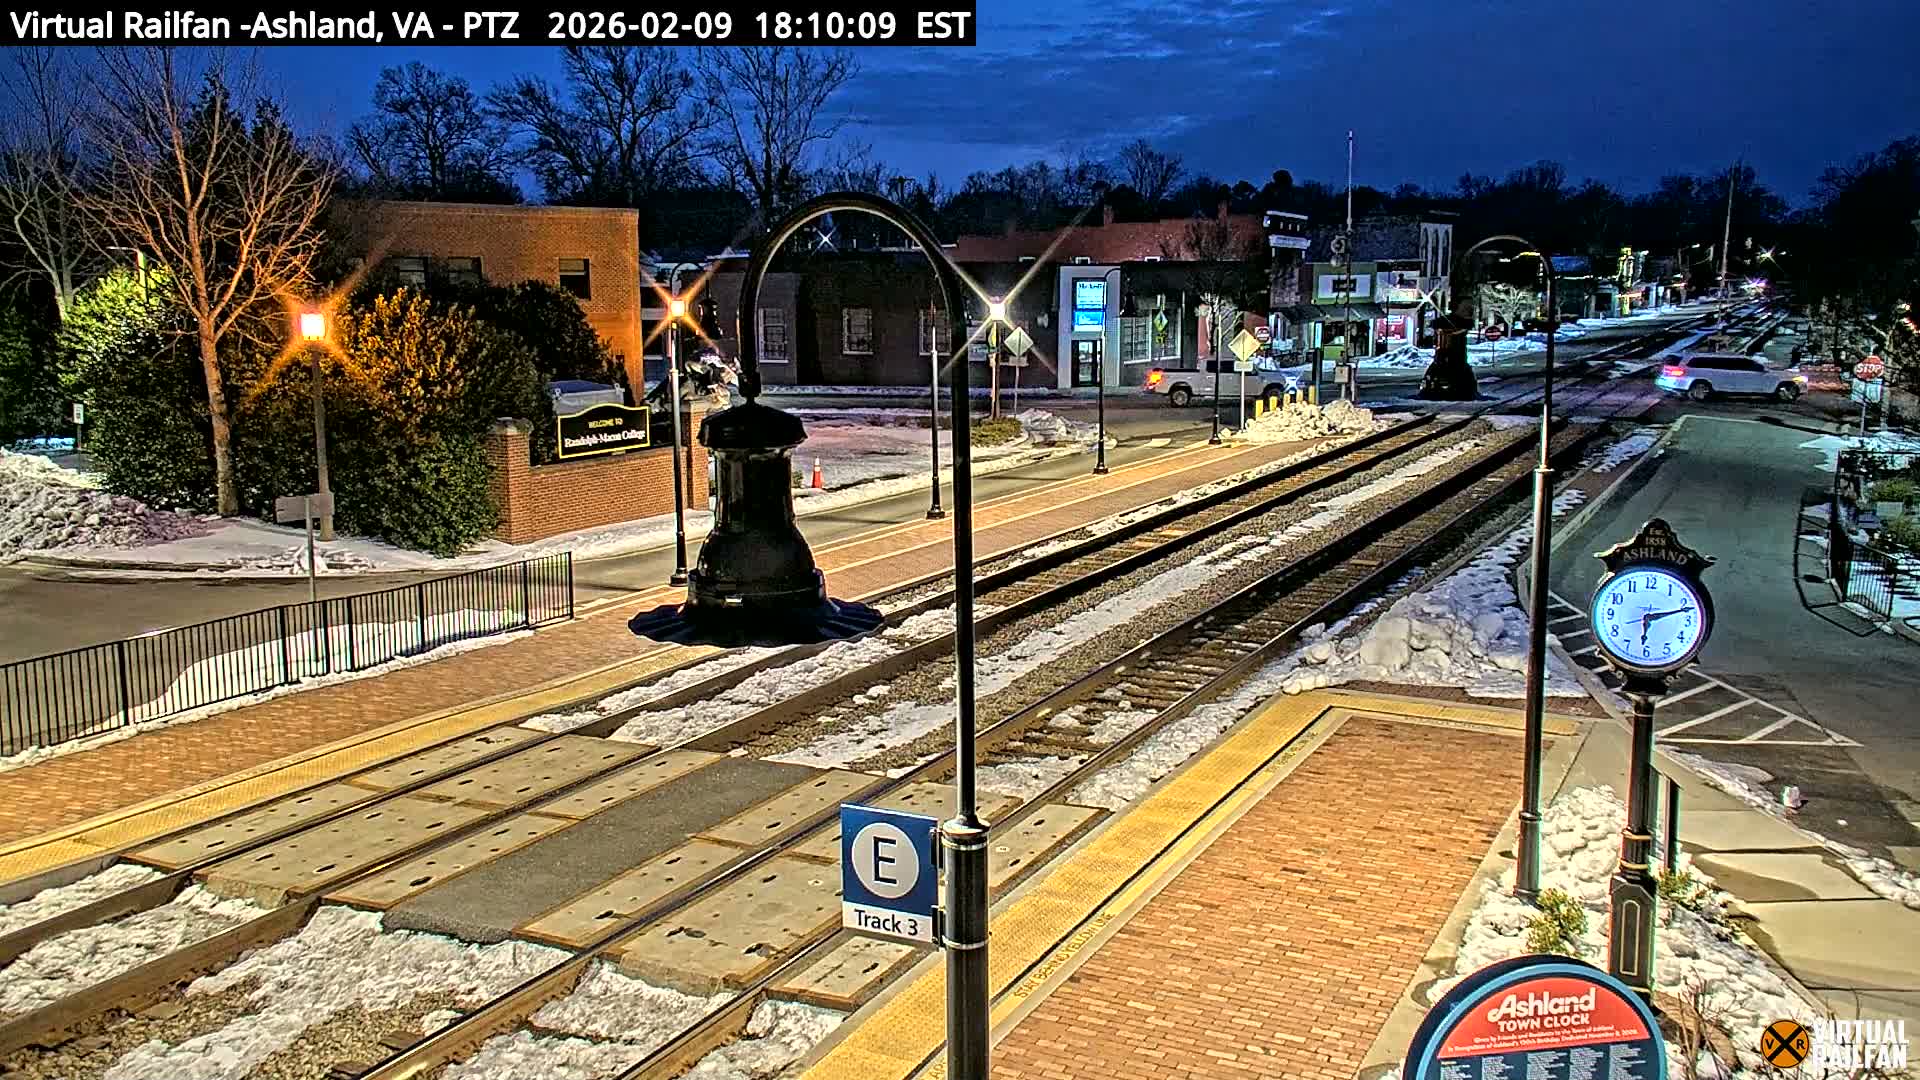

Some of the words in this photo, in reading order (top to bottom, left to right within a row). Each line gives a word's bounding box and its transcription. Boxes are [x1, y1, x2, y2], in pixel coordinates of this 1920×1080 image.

[1856, 363, 1882, 373] STOP
[1624, 547, 1687, 565] ASHLAND
[1628, 581, 1636, 592] 11
[1645, 577, 1657, 589] 12
[1668, 584, 1672, 596] 1
[1611, 593, 1623, 605] 10
[1680, 598, 1687, 610] 2
[1607, 608, 1615, 620] 9
[1684, 615, 1691, 627] 3
[1610, 624, 1619, 637] 8
[1677, 631, 1685, 643] 4
[1624, 639, 1630, 651] 7
[1662, 643, 1671, 655] 5
[1643, 646, 1650, 657] 6
[873, 836, 897, 884] E
[854, 908, 902, 934] Track
[907, 918, 918, 936] 3
[1488, 987, 1596, 1022] Ashland
[1498, 1018, 1540, 1032] TOWN
[1544, 1013, 1590, 1028] CLOCK
